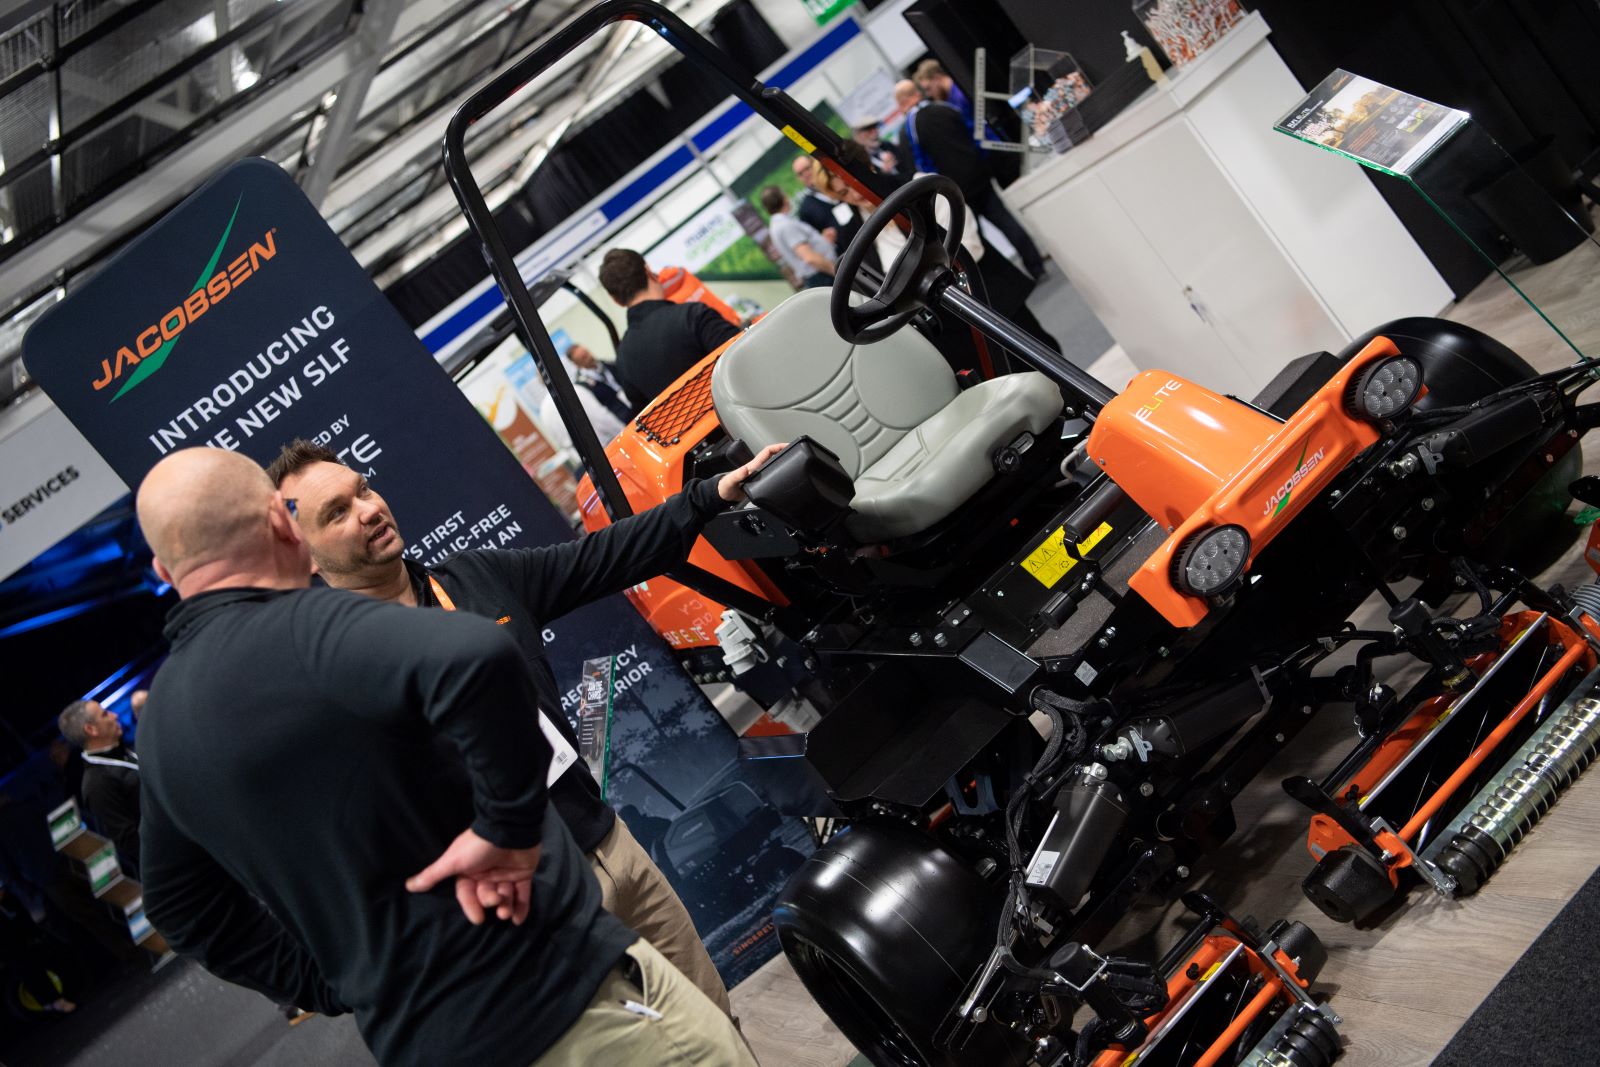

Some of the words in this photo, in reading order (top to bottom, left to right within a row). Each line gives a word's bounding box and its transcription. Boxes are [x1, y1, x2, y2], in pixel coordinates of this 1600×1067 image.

[92, 230, 277, 390] JACOBSEN
[149, 305, 335, 455] INTRODUCING
[235, 376, 302, 438] NEW
[303, 338, 351, 387] SLF
[1135, 379, 1182, 421] ELITE
[330, 413, 350, 435] BY
[2, 465, 80, 525] SERVICES
[1263, 448, 1325, 516] JACOBSEN
[421, 510, 466, 550] FIRST
[497, 521, 522, 546] AN
